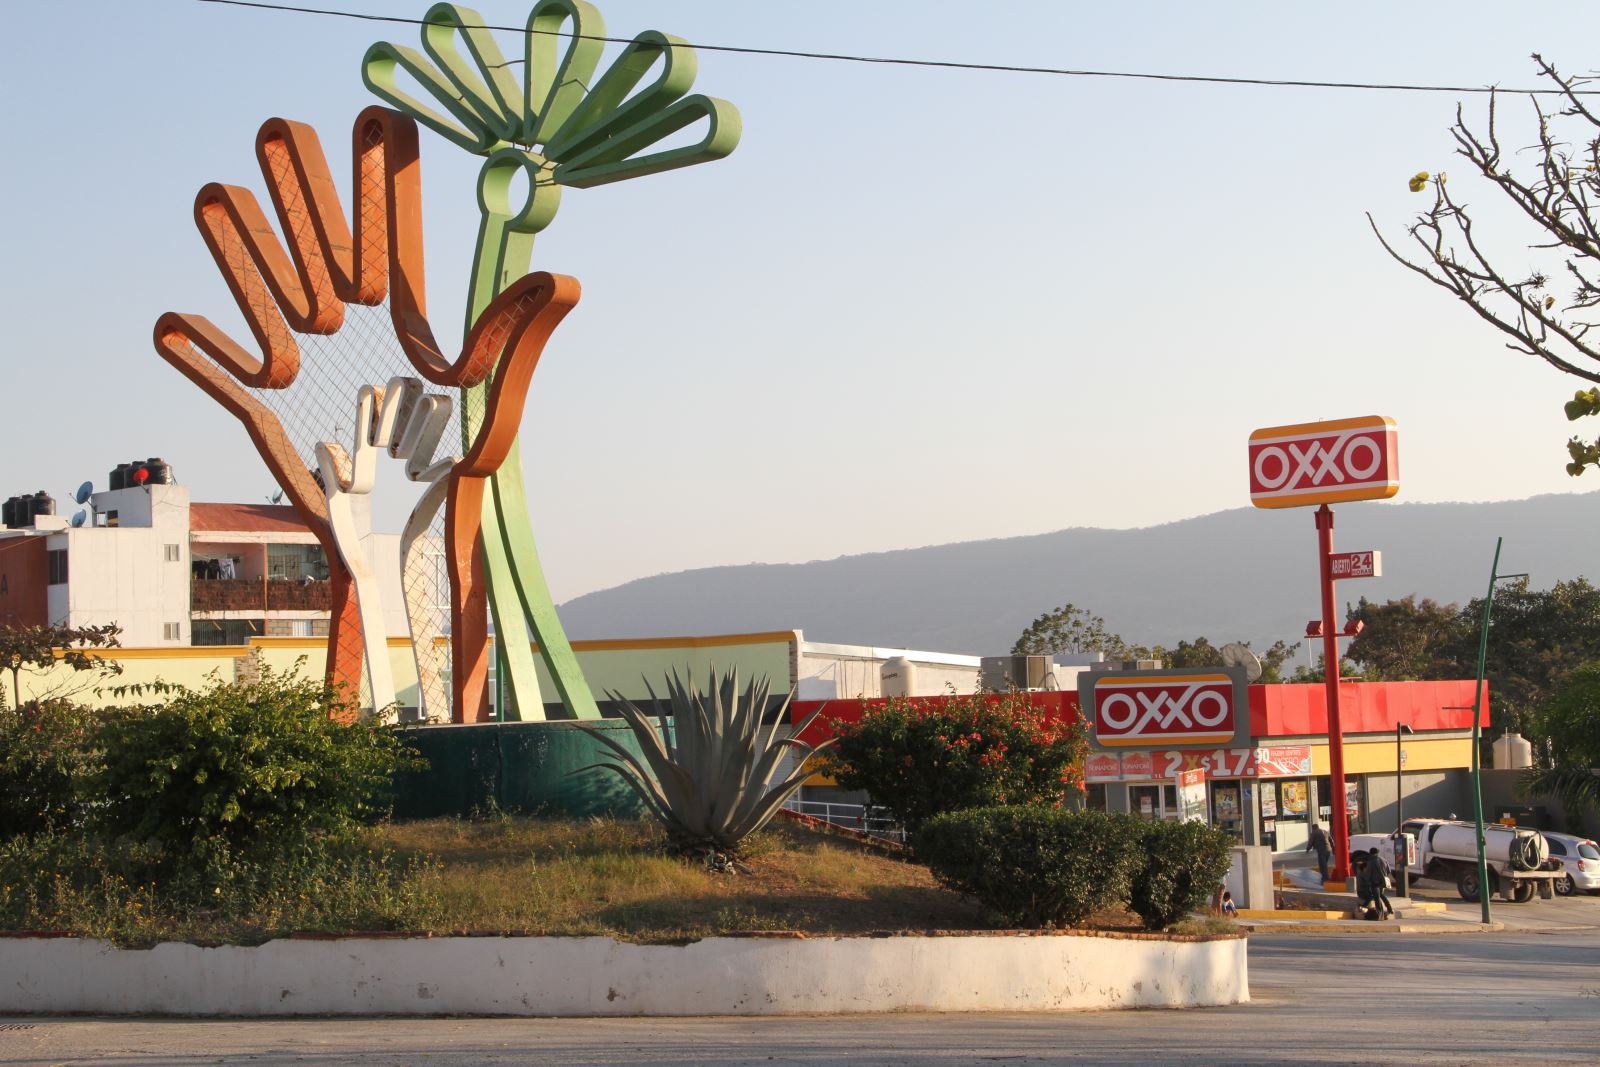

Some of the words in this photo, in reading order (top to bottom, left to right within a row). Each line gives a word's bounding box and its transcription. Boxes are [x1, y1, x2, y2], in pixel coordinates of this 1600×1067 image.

[1254, 434, 1382, 490] OXXO
[1332, 559, 1350, 574] ABIERTO
[1351, 554, 1371, 569] 24
[1101, 686, 1228, 733] OXXO
